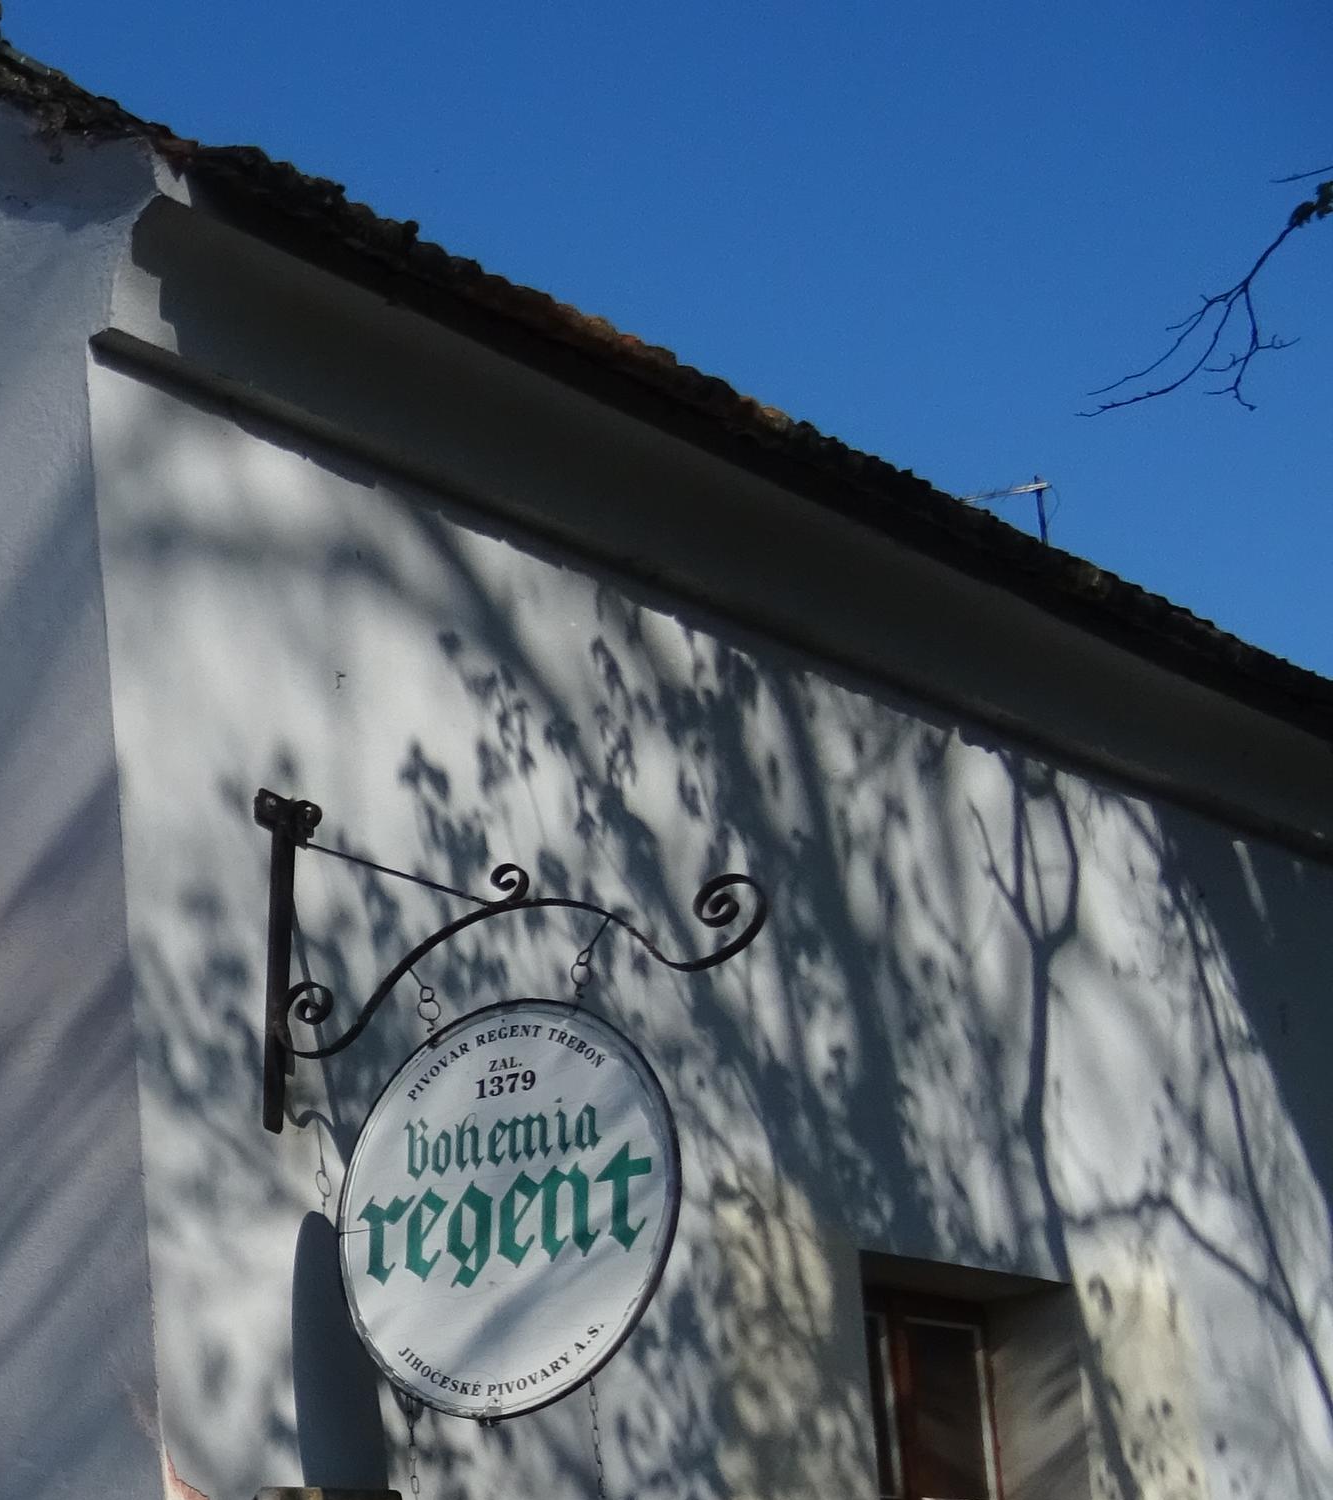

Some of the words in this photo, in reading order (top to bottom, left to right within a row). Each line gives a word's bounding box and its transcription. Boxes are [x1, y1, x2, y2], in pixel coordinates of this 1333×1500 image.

[407, 1042, 471, 1102] PIVOVAR
[475, 1024, 542, 1048] REGENT
[475, 1069, 537, 1100] 1379
[488, 1056, 523, 1073] ZAL.
[403, 1097, 602, 1181] Bohemia
[357, 1141, 652, 1288] regent
[398, 1346, 482, 1397] JIHOČESKÉ
[486, 1352, 571, 1397] PIVOVARY
